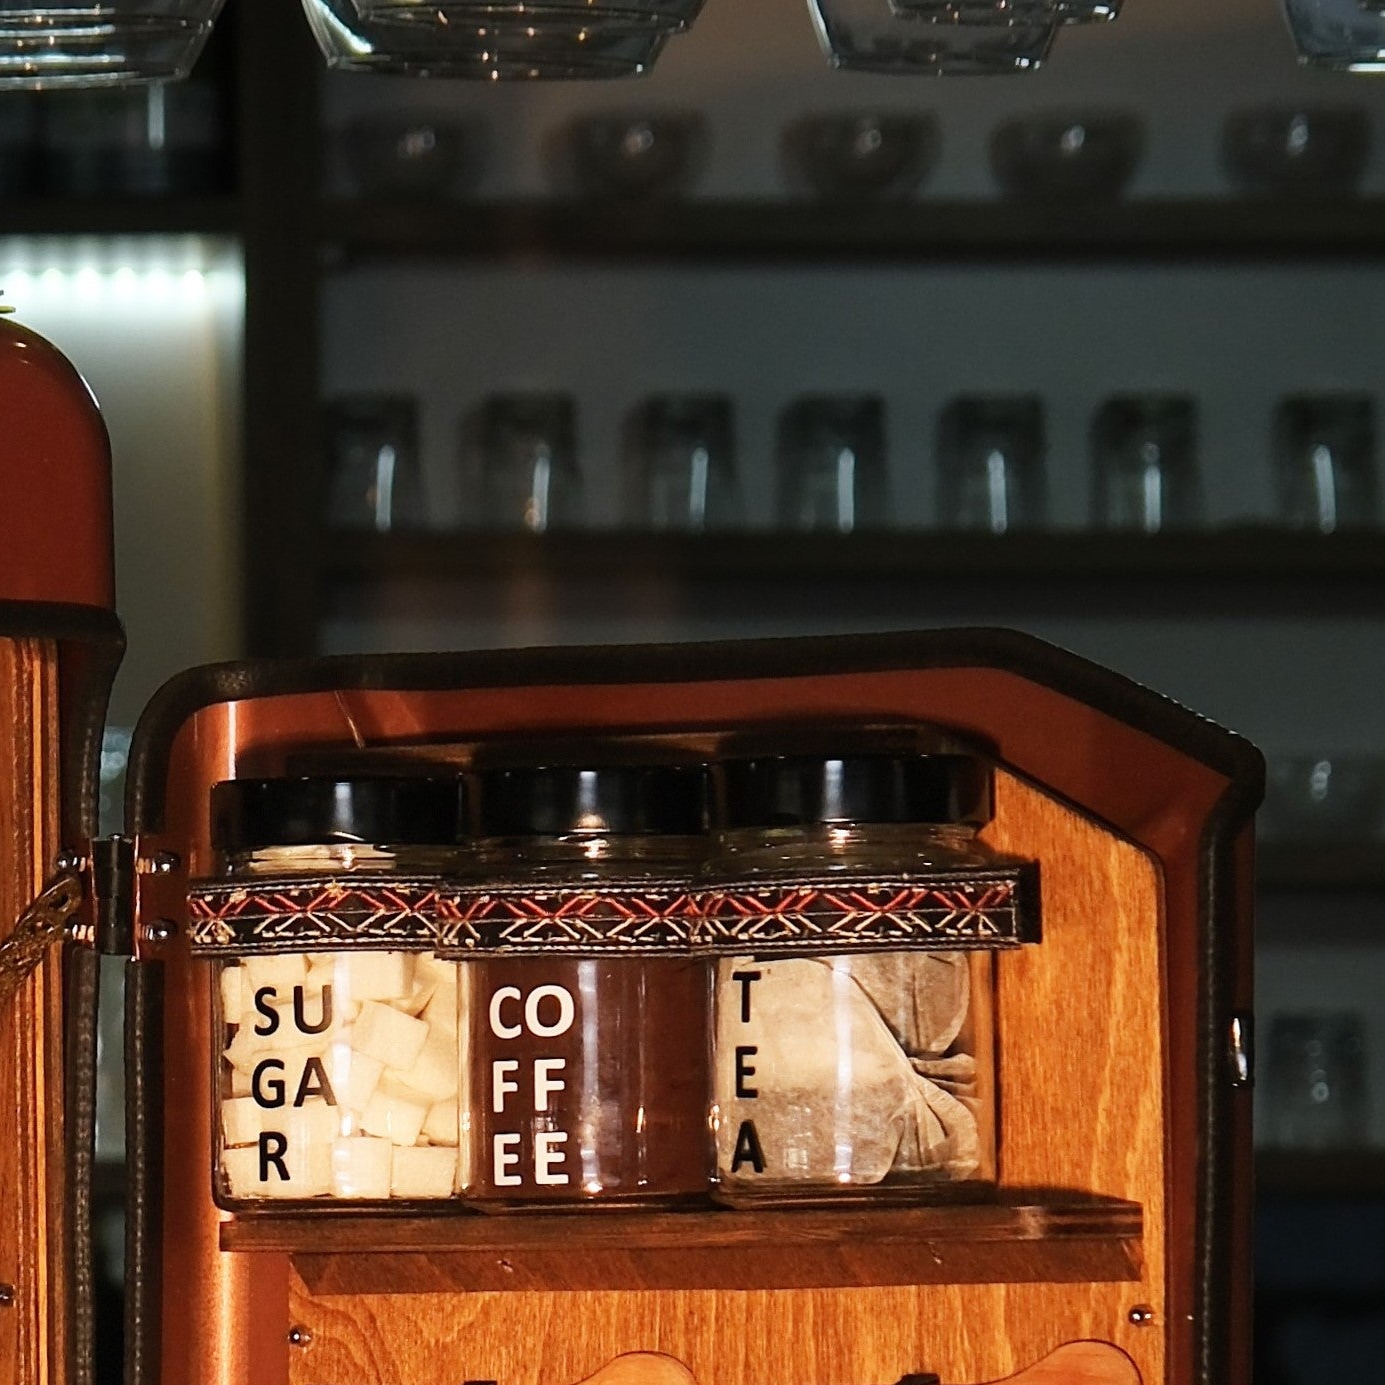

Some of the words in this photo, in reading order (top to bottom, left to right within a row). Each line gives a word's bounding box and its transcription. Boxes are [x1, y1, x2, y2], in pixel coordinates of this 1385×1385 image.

[253, 985, 333, 1036] SU
[489, 985, 575, 1039] CO
[251, 1057, 337, 1108] GA
[492, 1059, 566, 1113] FF
[258, 1131, 291, 1182] R
[493, 1132, 569, 1186] EE
